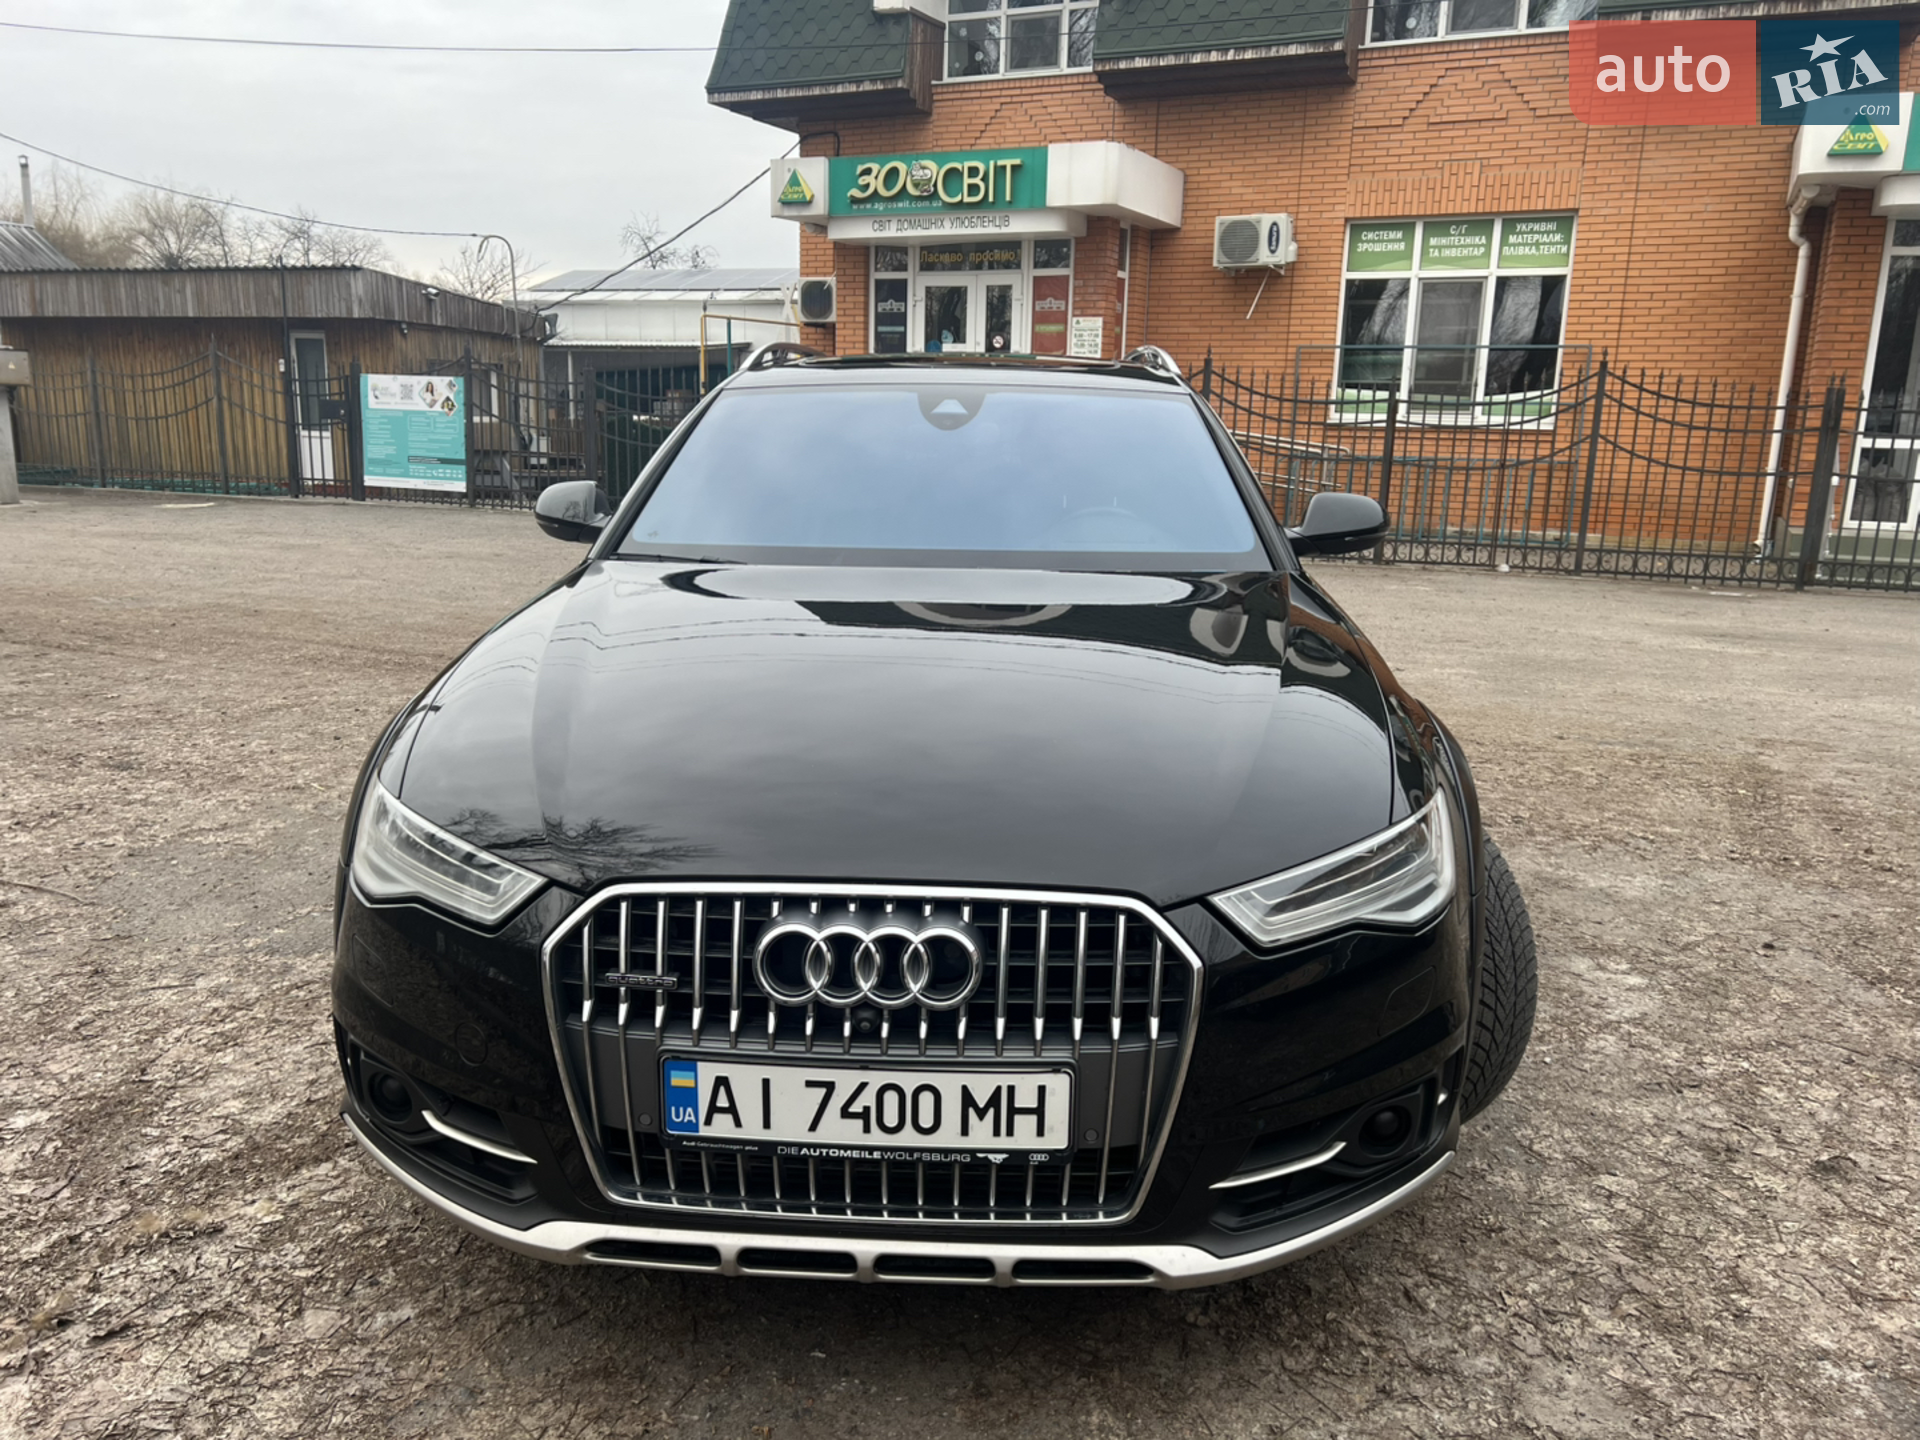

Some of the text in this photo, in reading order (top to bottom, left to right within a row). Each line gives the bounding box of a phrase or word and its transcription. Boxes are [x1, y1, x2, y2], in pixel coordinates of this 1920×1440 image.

[872, 215, 1010, 233] СВІТ ДОМАШНІХ УЛЮБЛЕНЦІВ
[1515, 221, 1557, 232] УКРИВНІ
[1361, 230, 1403, 240] СИСТЕМИ
[1450, 224, 1468, 236] С/Г
[1429, 235, 1487, 246] МІНІТЕХНІКА
[1508, 233, 1565, 244] МАТЕРІАЛИ:
[1356, 241, 1406, 252] ЗРОШЕННЯ
[1429, 246, 1485, 257] ТА ІНВЕНТАР
[920, 251, 964, 262] Ласкаво
[608, 975, 674, 987] quattro
[703, 1075, 1047, 1138] AI 7400 MH
[671, 1107, 696, 1123] UA
